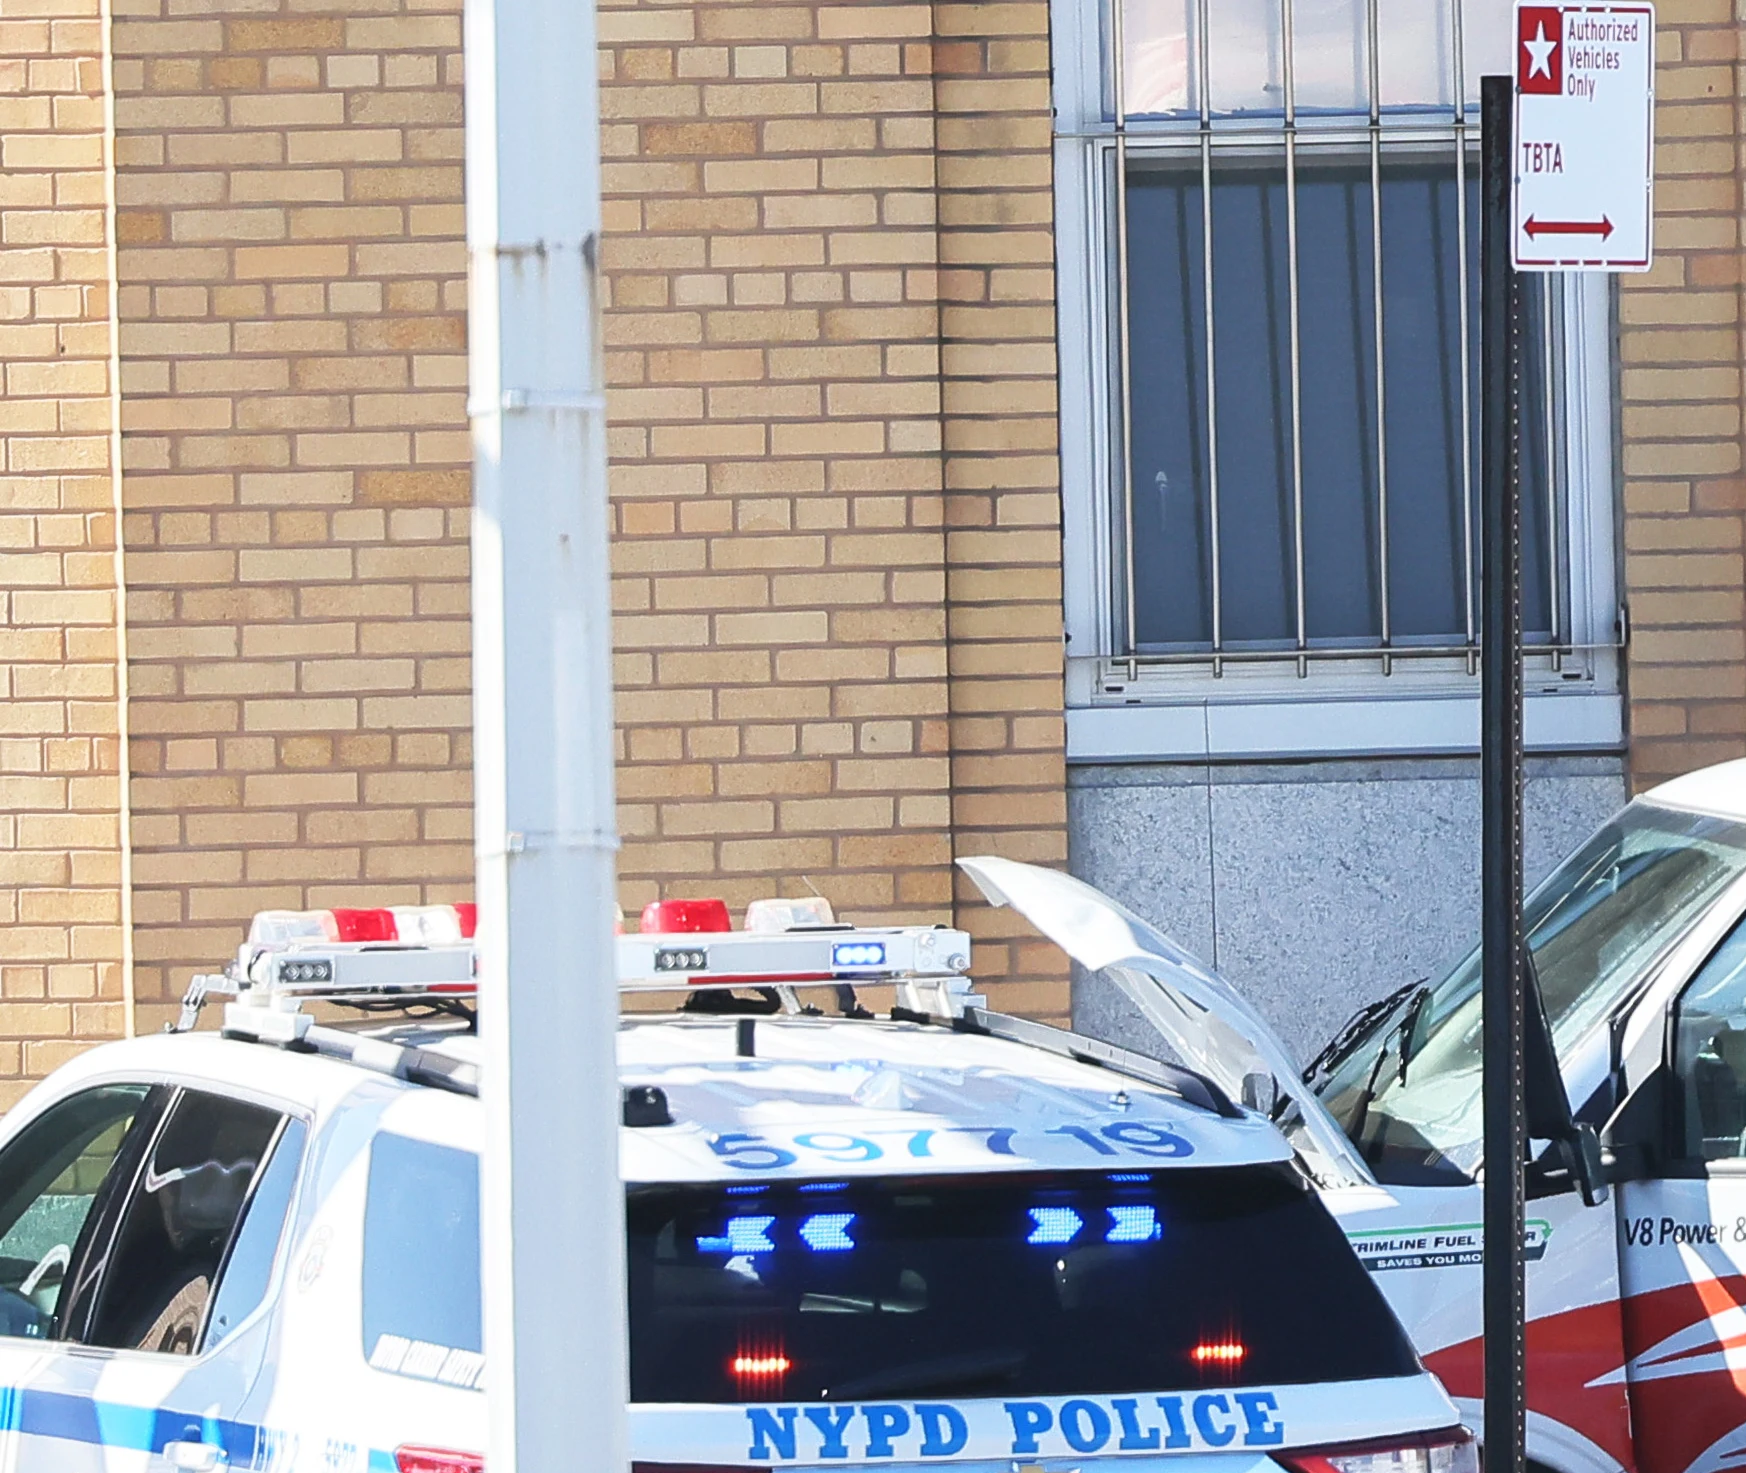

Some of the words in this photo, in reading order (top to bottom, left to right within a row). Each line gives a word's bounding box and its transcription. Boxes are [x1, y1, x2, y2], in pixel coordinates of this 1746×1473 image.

[1568, 18, 1638, 42] Authorized
[1568, 45, 1620, 70] Vehicles
[1568, 73, 1596, 102] Only
[1522, 142, 1563, 173] TBTA
[1048, 1121, 1196, 1158] 19
[1434, 1236, 1476, 1247] FUEL
[1623, 1215, 1654, 1247] V8
[1658, 1216, 1728, 1247] Power
[1377, 1258, 1422, 1268] SAVES
[1426, 1256, 1455, 1265] YOU
[748, 1404, 969, 1459] NYPD
[1004, 1392, 1285, 1454] POLICE
